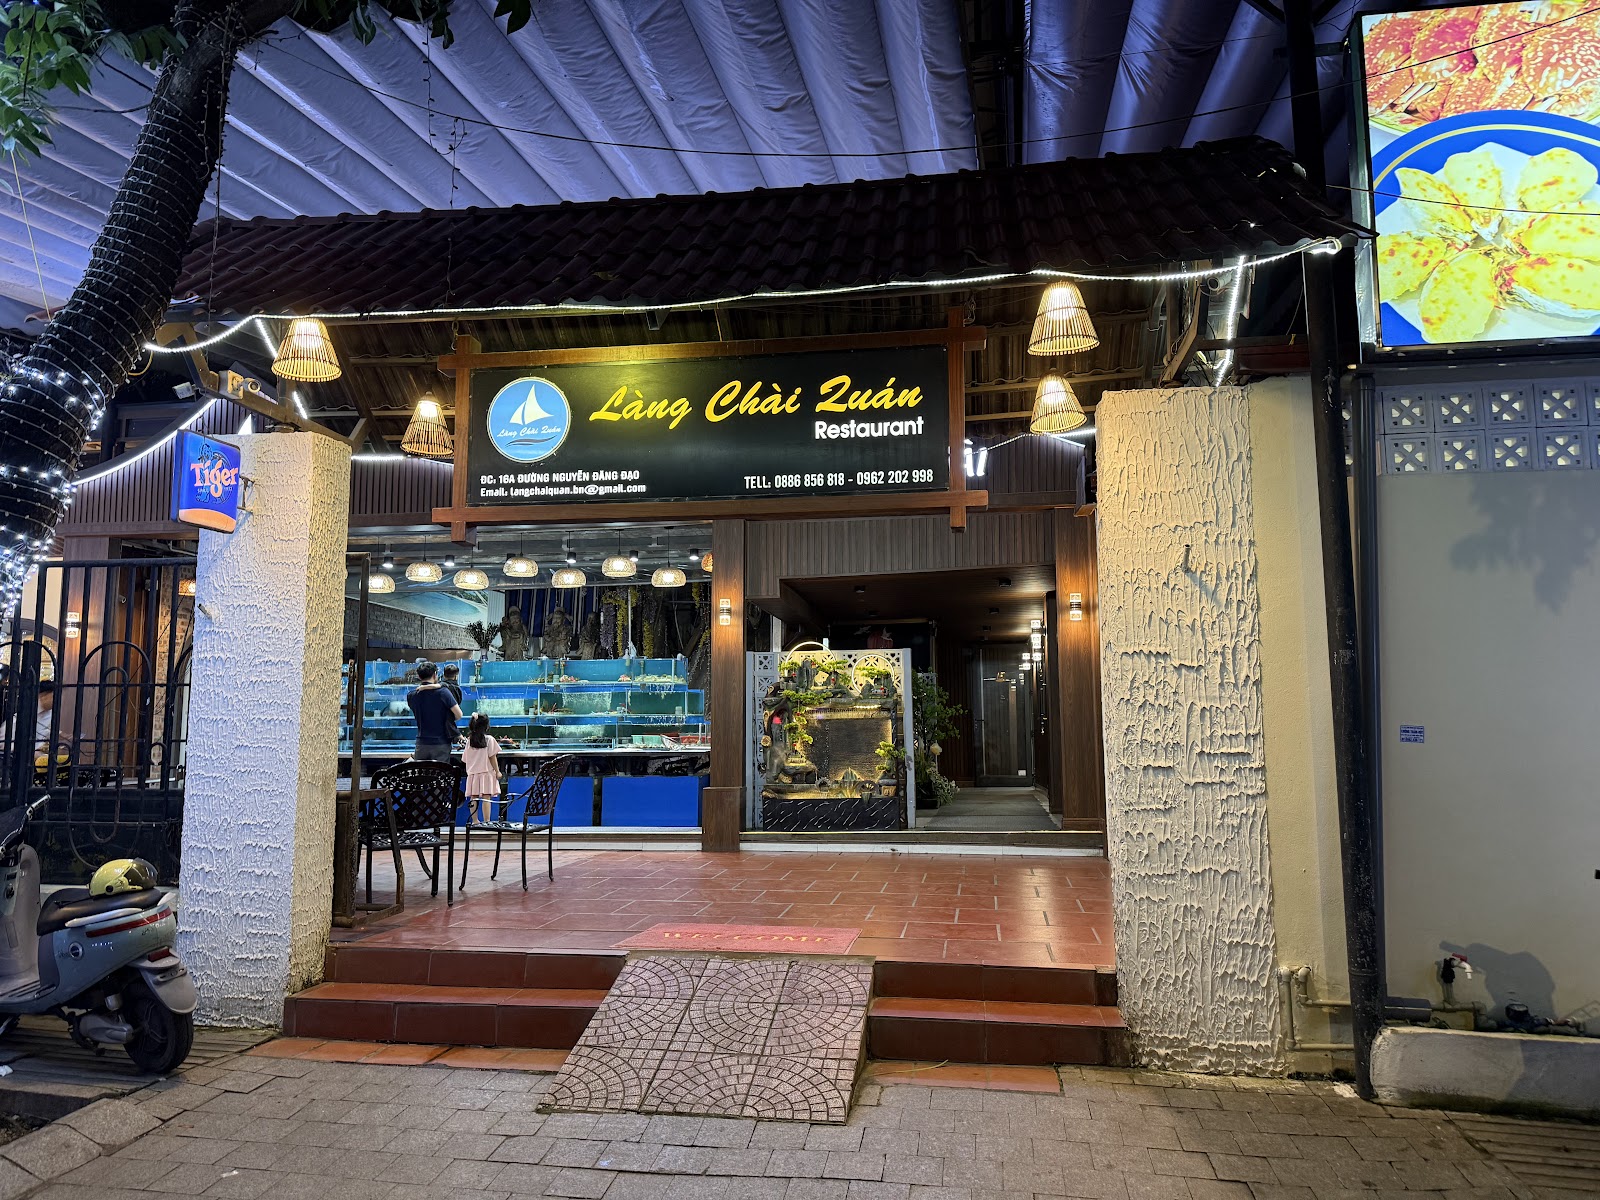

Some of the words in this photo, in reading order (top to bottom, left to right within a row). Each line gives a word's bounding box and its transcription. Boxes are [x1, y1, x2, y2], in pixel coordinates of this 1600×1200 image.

[589, 385, 692, 430] Làng
[705, 380, 802, 423] Chài
[815, 374, 924, 413] Quán
[814, 416, 924, 440] Restaurant
[190, 459, 239, 498] Tiger
[499, 474, 515, 484] 16A
[517, 472, 550, 483] ĐƯỜNG
[552, 470, 590, 482] NGUYỄN
[620, 470, 640, 481] ĐẠO
[743, 475, 771, 489] TELL:
[774, 474, 801, 488] 0886
[804, 473, 824, 487] 856
[827, 472, 845, 486] 818
[856, 471, 885, 485] 0962
[887, 470, 909, 484] 202
[912, 469, 934, 483] 998
